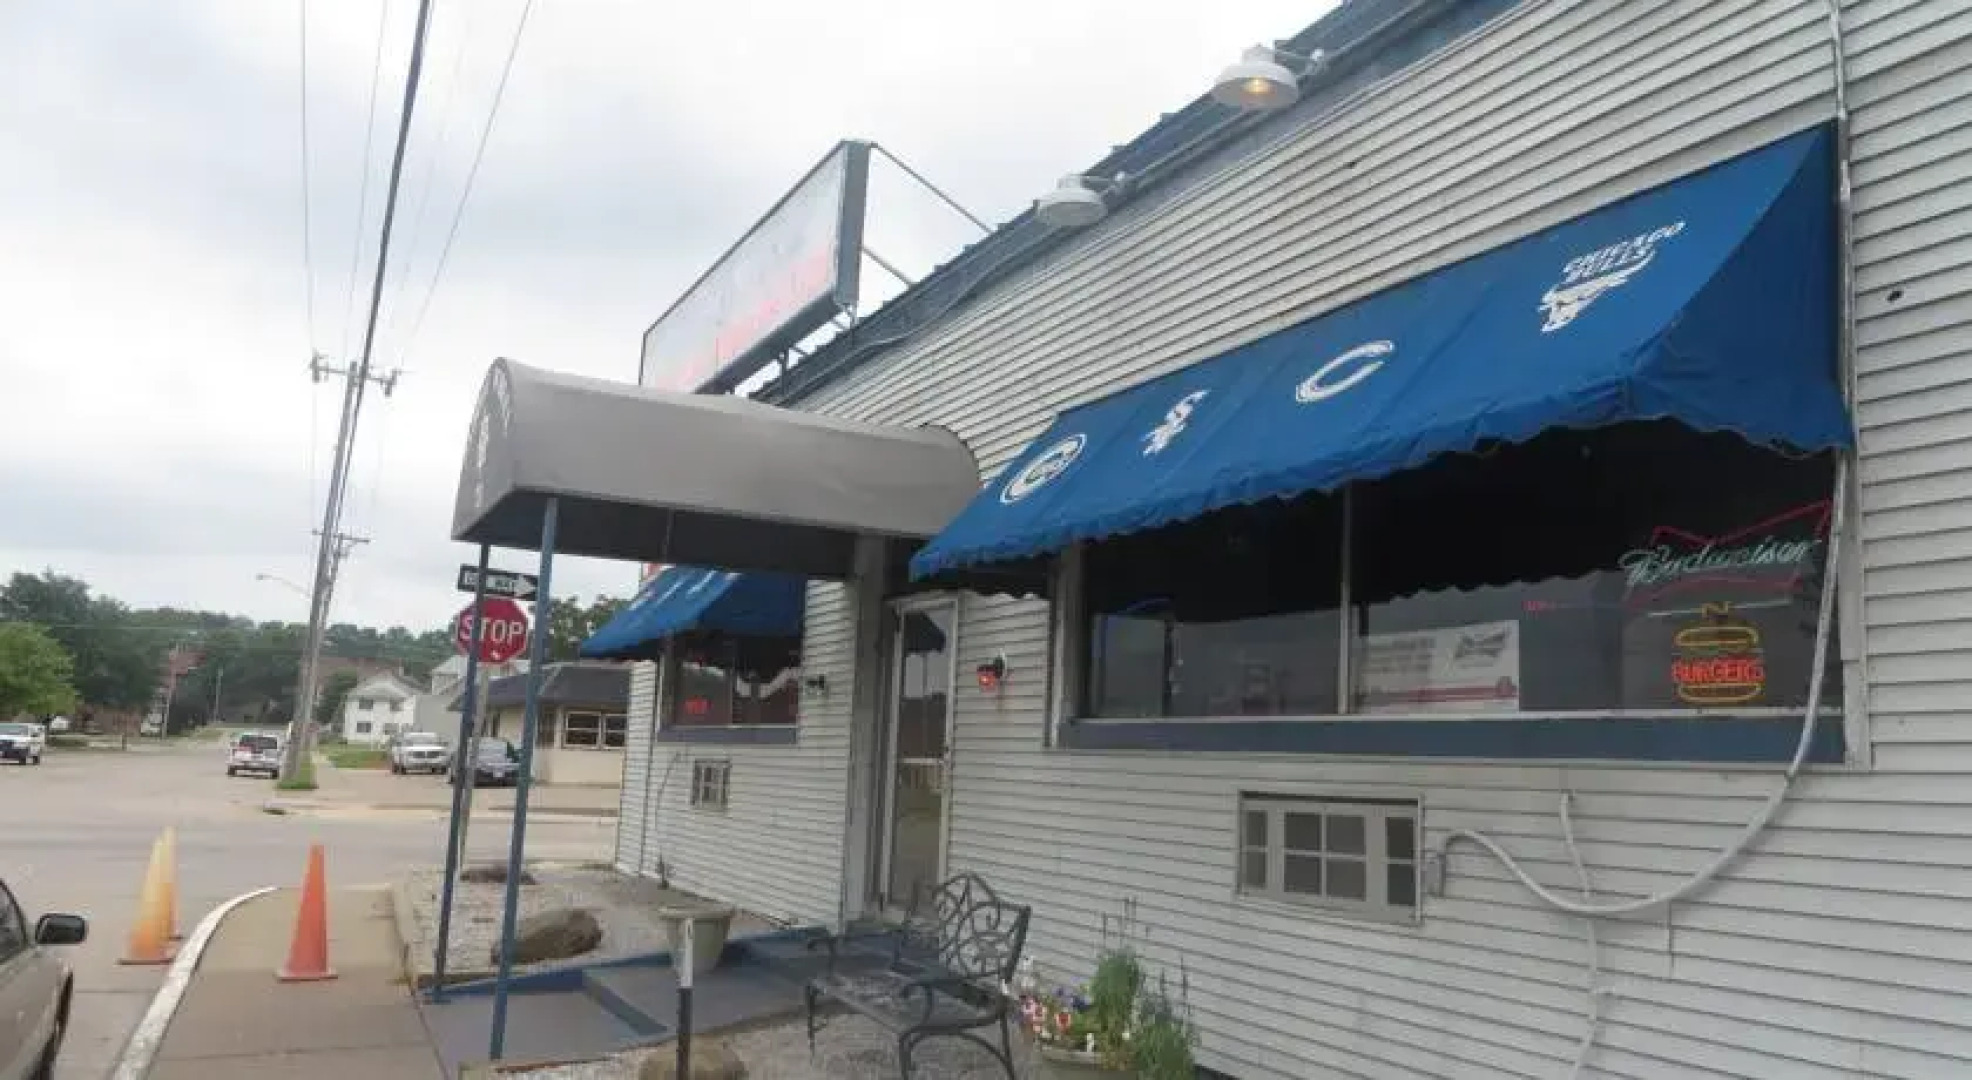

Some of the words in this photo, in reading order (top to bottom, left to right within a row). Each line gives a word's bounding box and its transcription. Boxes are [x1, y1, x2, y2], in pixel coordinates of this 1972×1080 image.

[1565, 244, 1653, 283] BULLS
[1617, 535, 1822, 598] Budweiser
[459, 615, 524, 645] STOP
[1671, 655, 1765, 683] BURGERS
